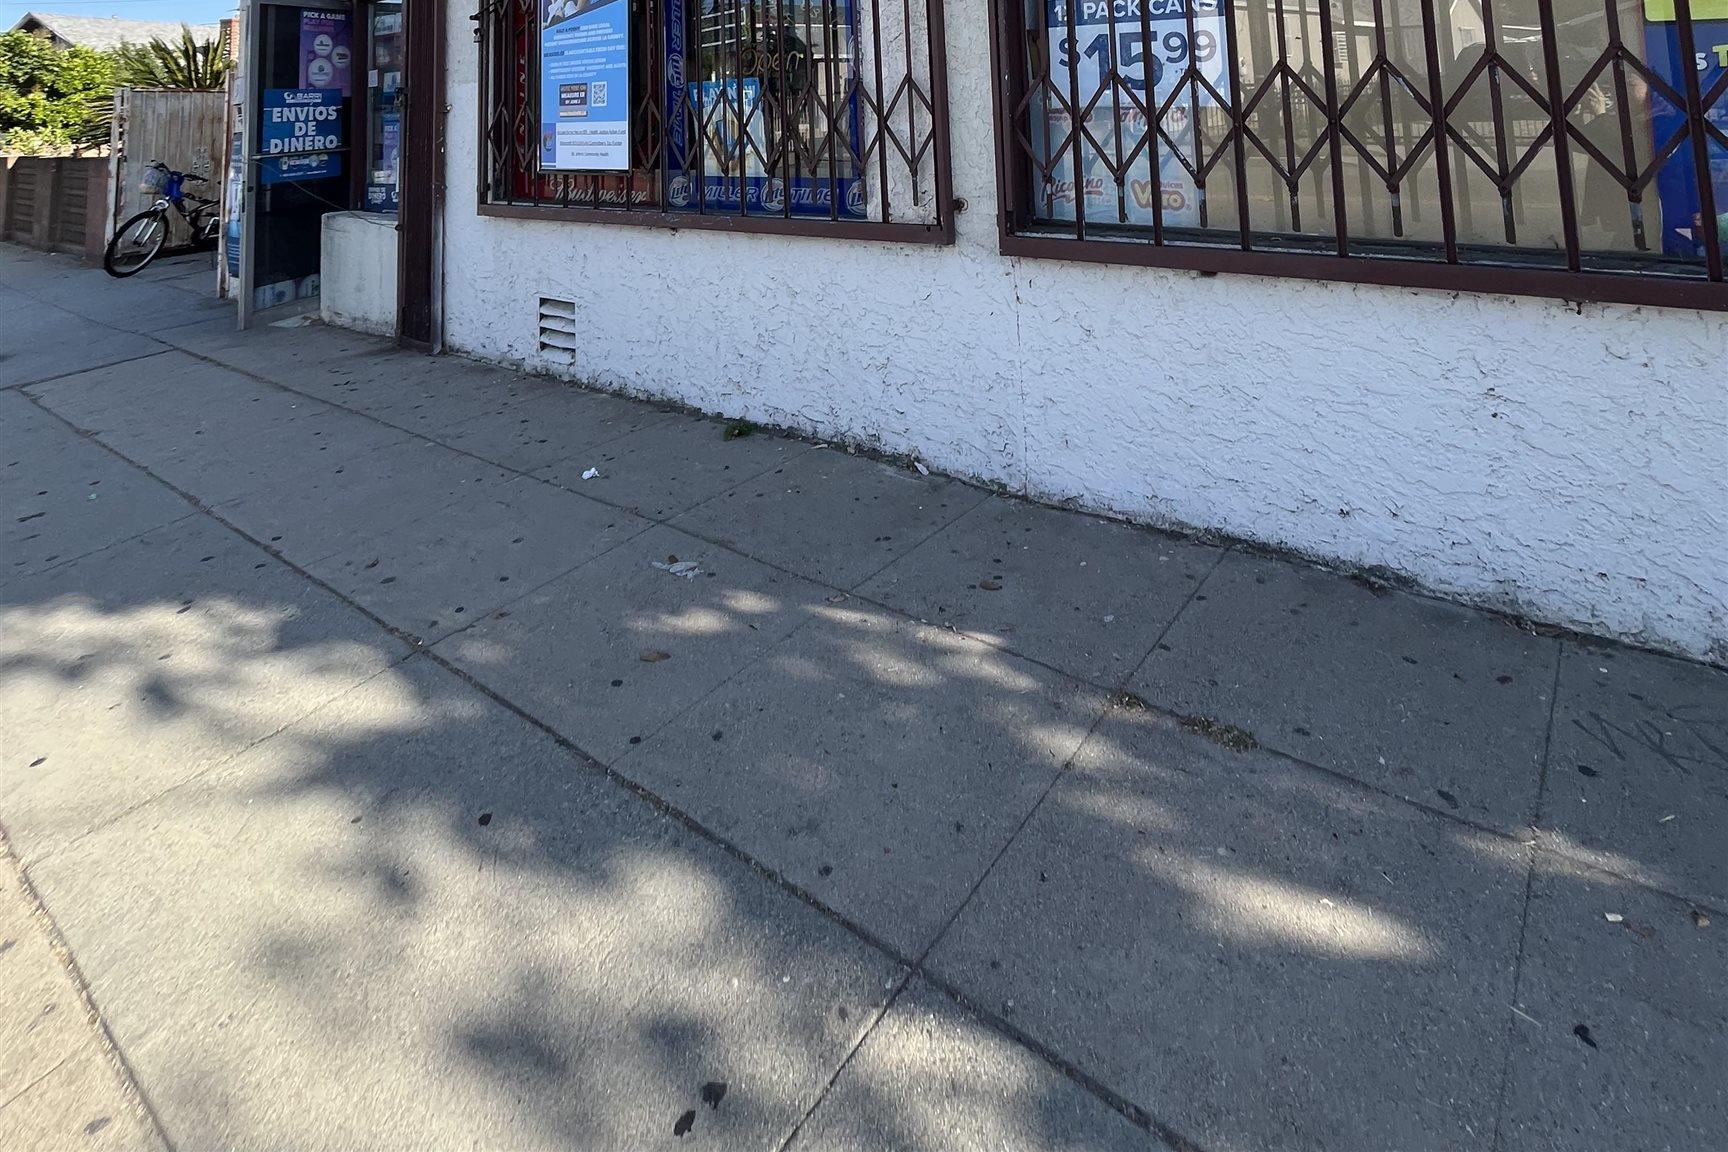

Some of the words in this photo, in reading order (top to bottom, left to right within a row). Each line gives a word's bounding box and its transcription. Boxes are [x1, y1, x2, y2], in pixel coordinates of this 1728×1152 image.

[303, 11, 319, 19] PICK
[1083, 0, 1140, 20] PACK
[294, 121, 317, 137] DE
[270, 135, 338, 153] DINERO
